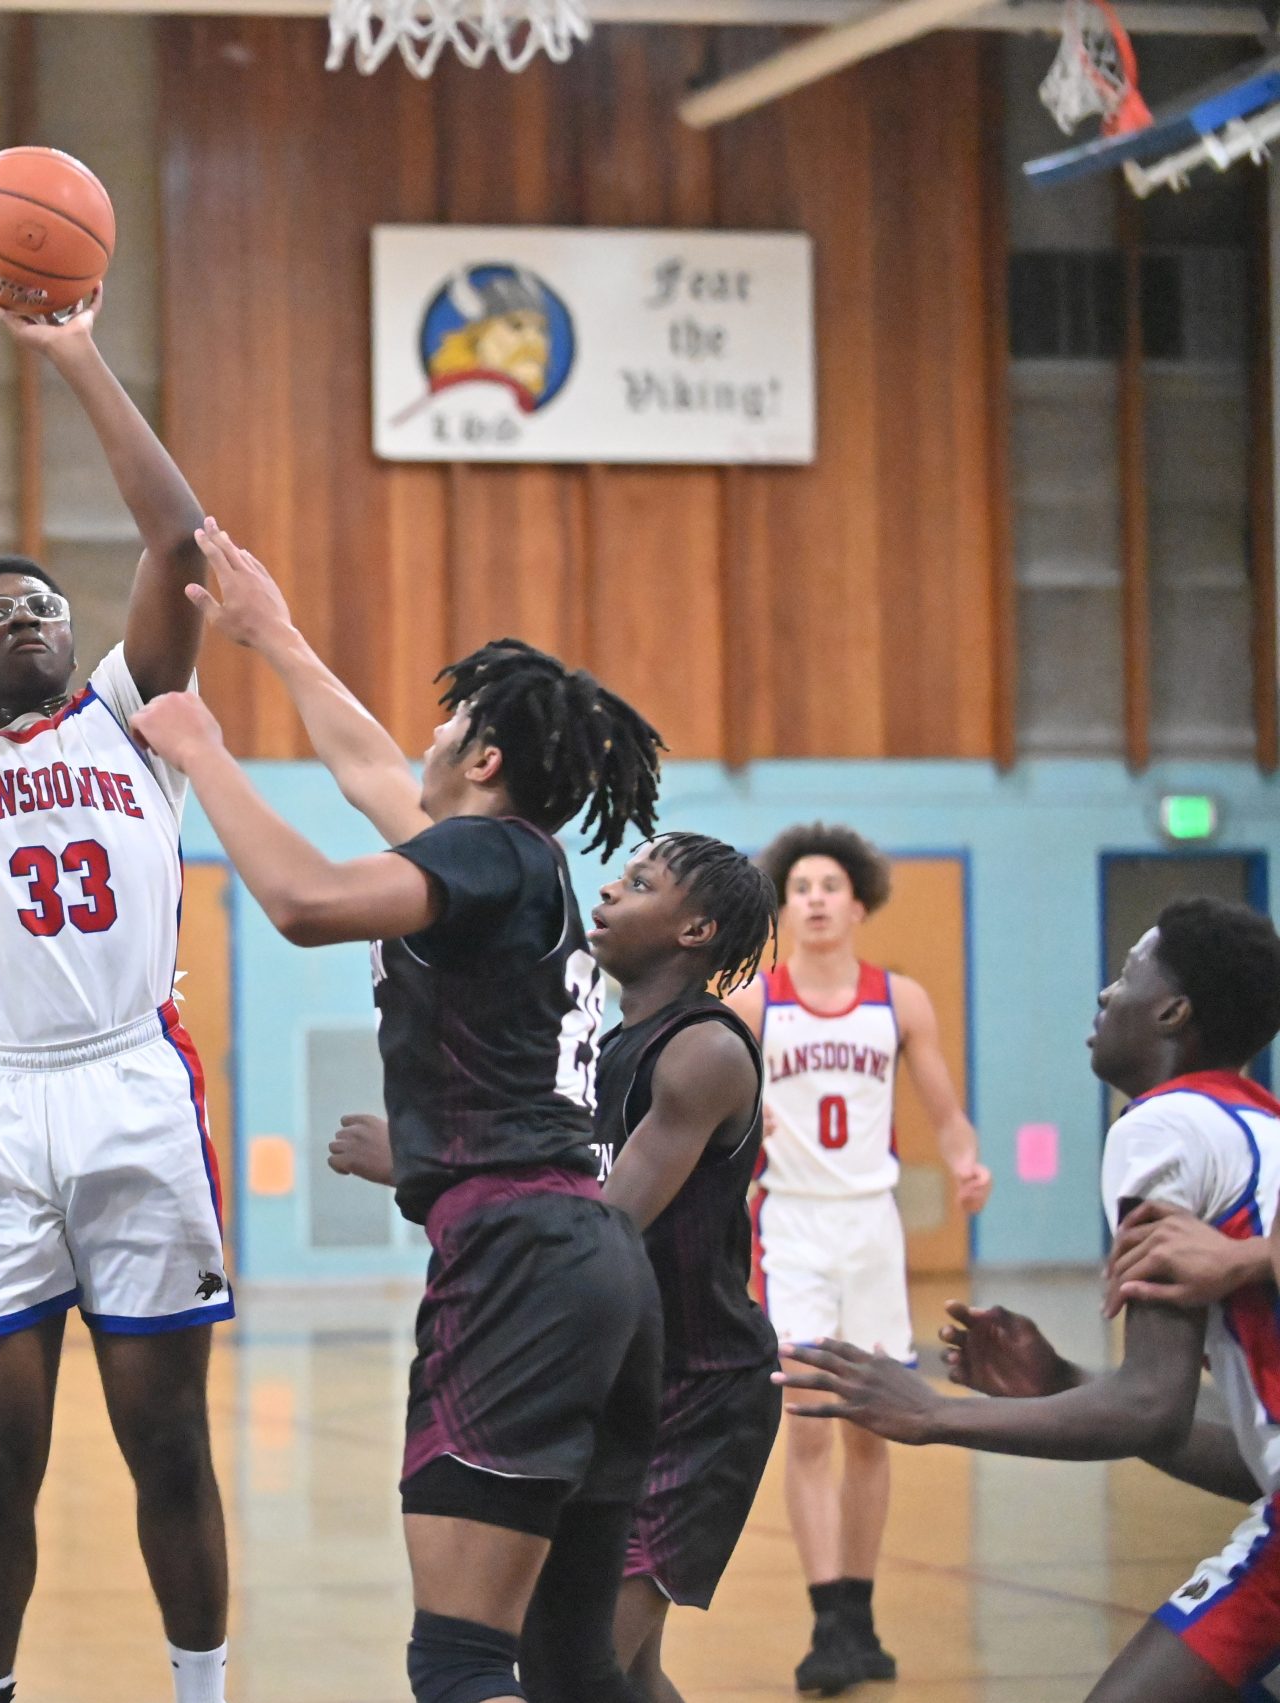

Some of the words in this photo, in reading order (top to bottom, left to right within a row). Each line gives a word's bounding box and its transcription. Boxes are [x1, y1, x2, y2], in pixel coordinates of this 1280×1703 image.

[669, 317, 727, 358] the
[8, 838, 118, 937] 33
[768, 1041, 890, 1084] LANSDOWNE
[818, 1093, 849, 1149] 0
